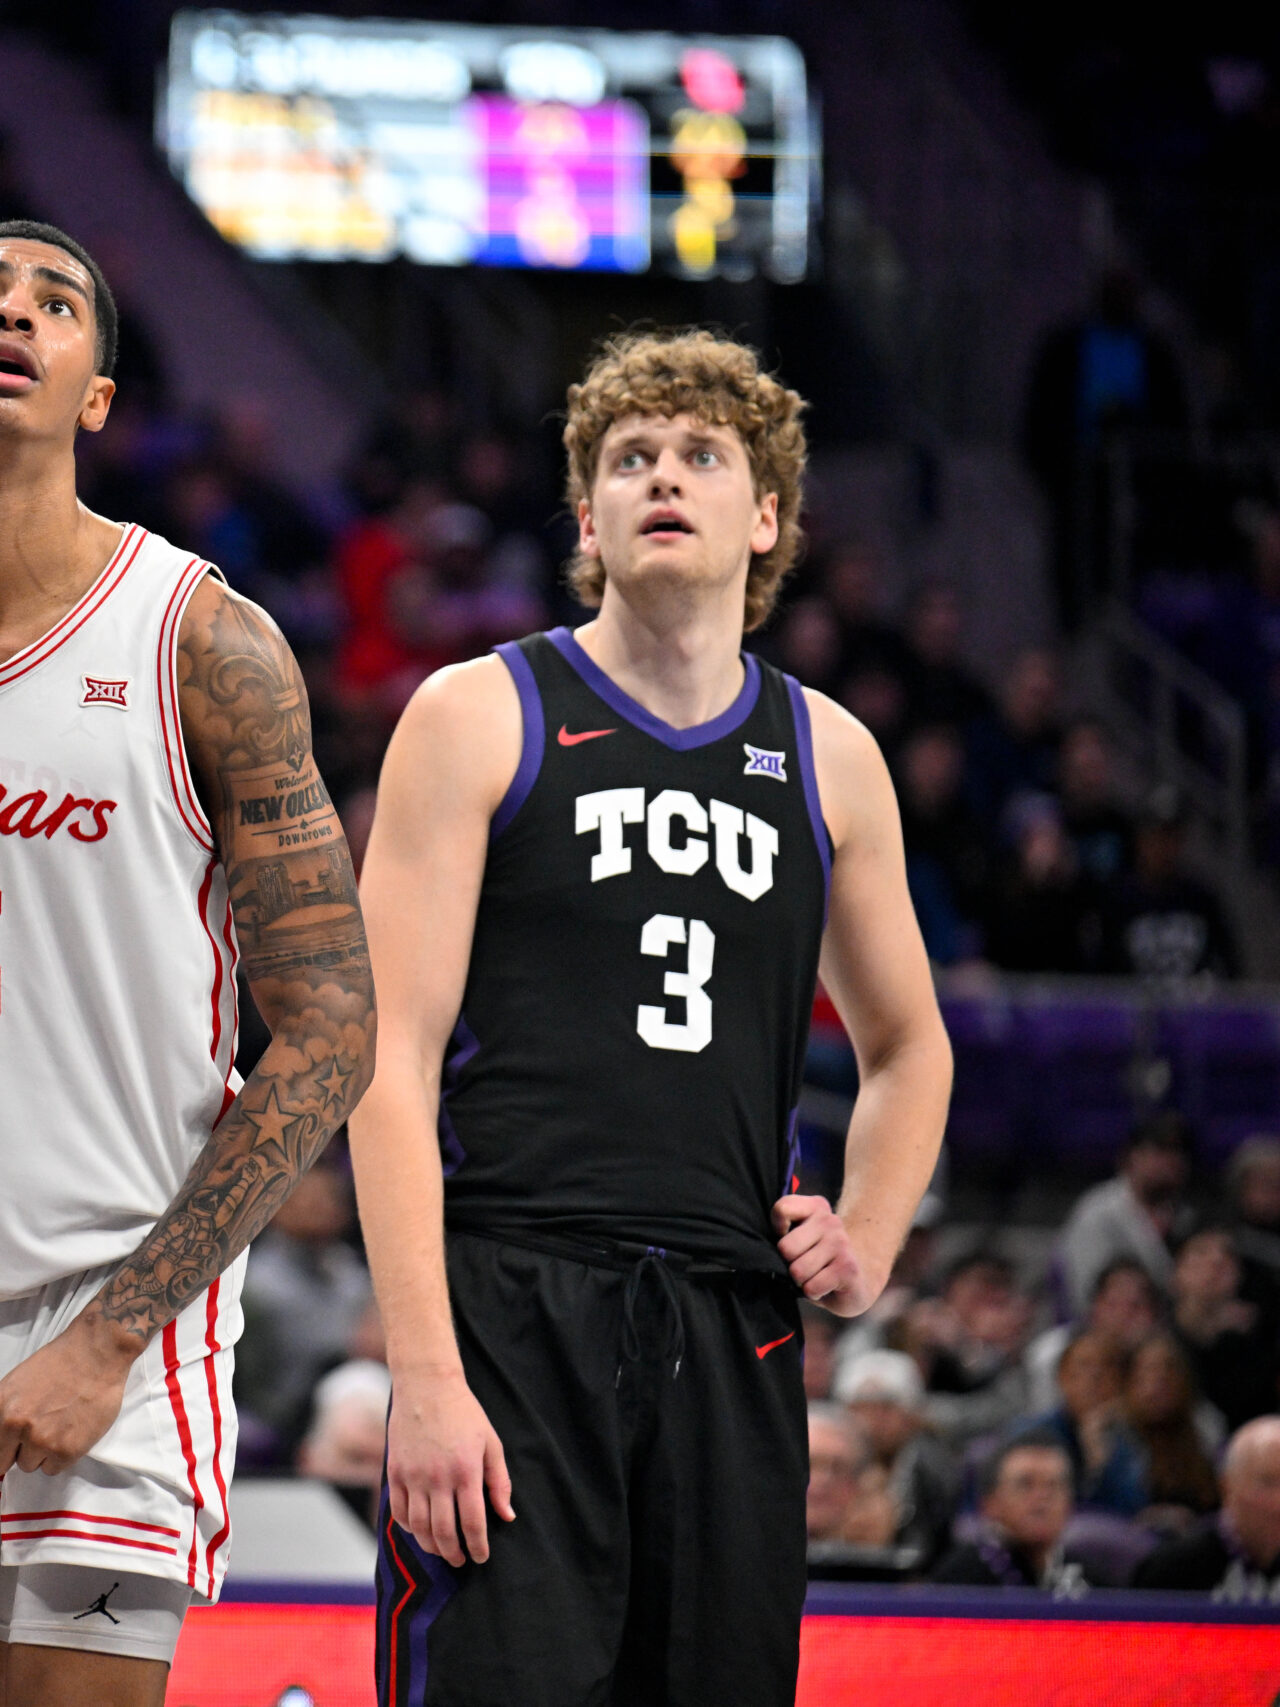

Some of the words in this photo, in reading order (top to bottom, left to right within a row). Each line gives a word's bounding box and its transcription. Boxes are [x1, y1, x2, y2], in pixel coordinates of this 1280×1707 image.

[86, 679, 126, 704] XII
[747, 747, 785, 779] XII
[239, 795, 284, 826] NEW
[286, 779, 331, 818] ORLEAN
[278, 825, 332, 848] DOWNTOWN
[575, 787, 778, 901] TCU
[637, 914, 715, 1052] 3
